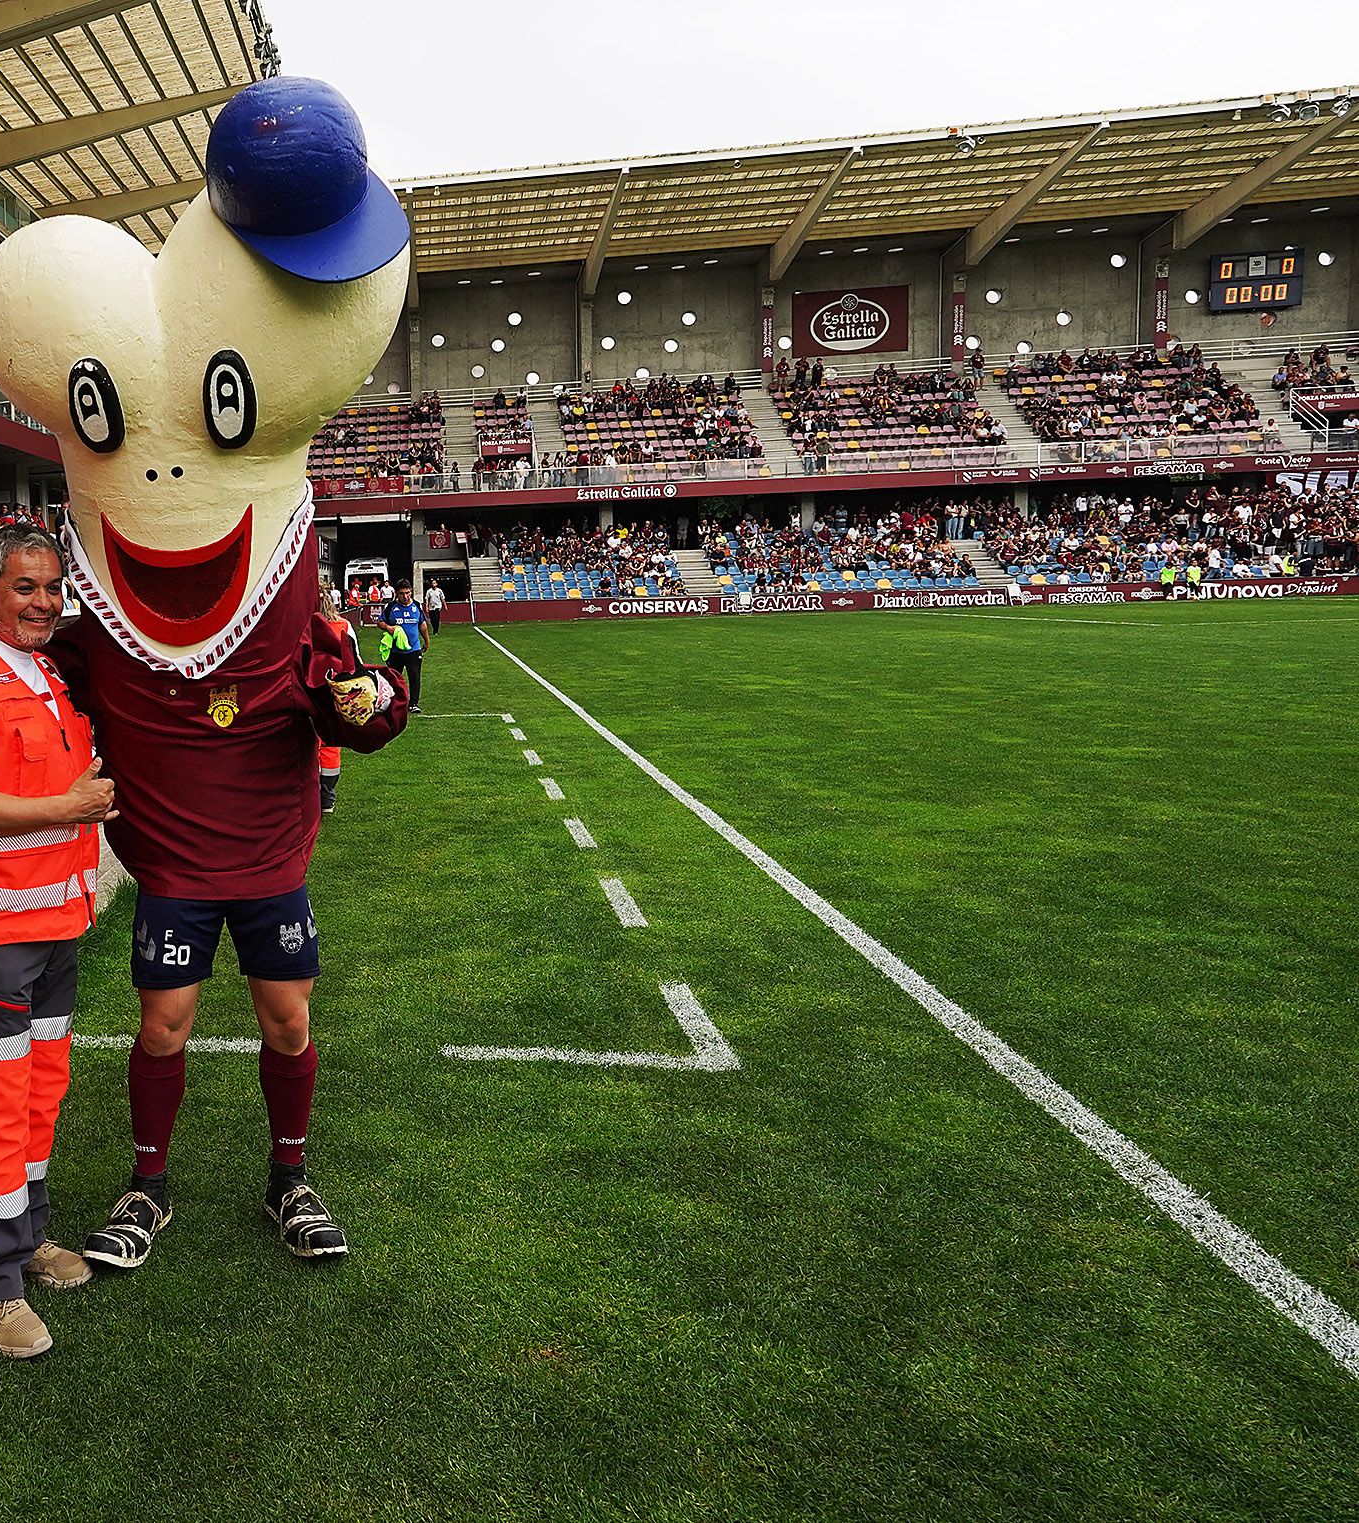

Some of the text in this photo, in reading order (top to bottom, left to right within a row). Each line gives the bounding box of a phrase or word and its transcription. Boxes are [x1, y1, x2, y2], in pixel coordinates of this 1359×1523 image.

[1220, 262, 1233, 279] 0
[1282, 257, 1295, 274] 0
[821, 309, 879, 326] Estrella
[824, 325, 876, 340] Galicia
[1134, 463, 1205, 476] PESCAMAR
[577, 485, 661, 500] Estrella Galicia
[608, 600, 709, 614] CONSERVAS
[721, 594, 825, 613] PCAMAR
[1049, 592, 1125, 604] PESCAMAR
[165, 929, 173, 941] F
[163, 944, 191, 966] 20
[134, 1142, 157, 1152] oma
